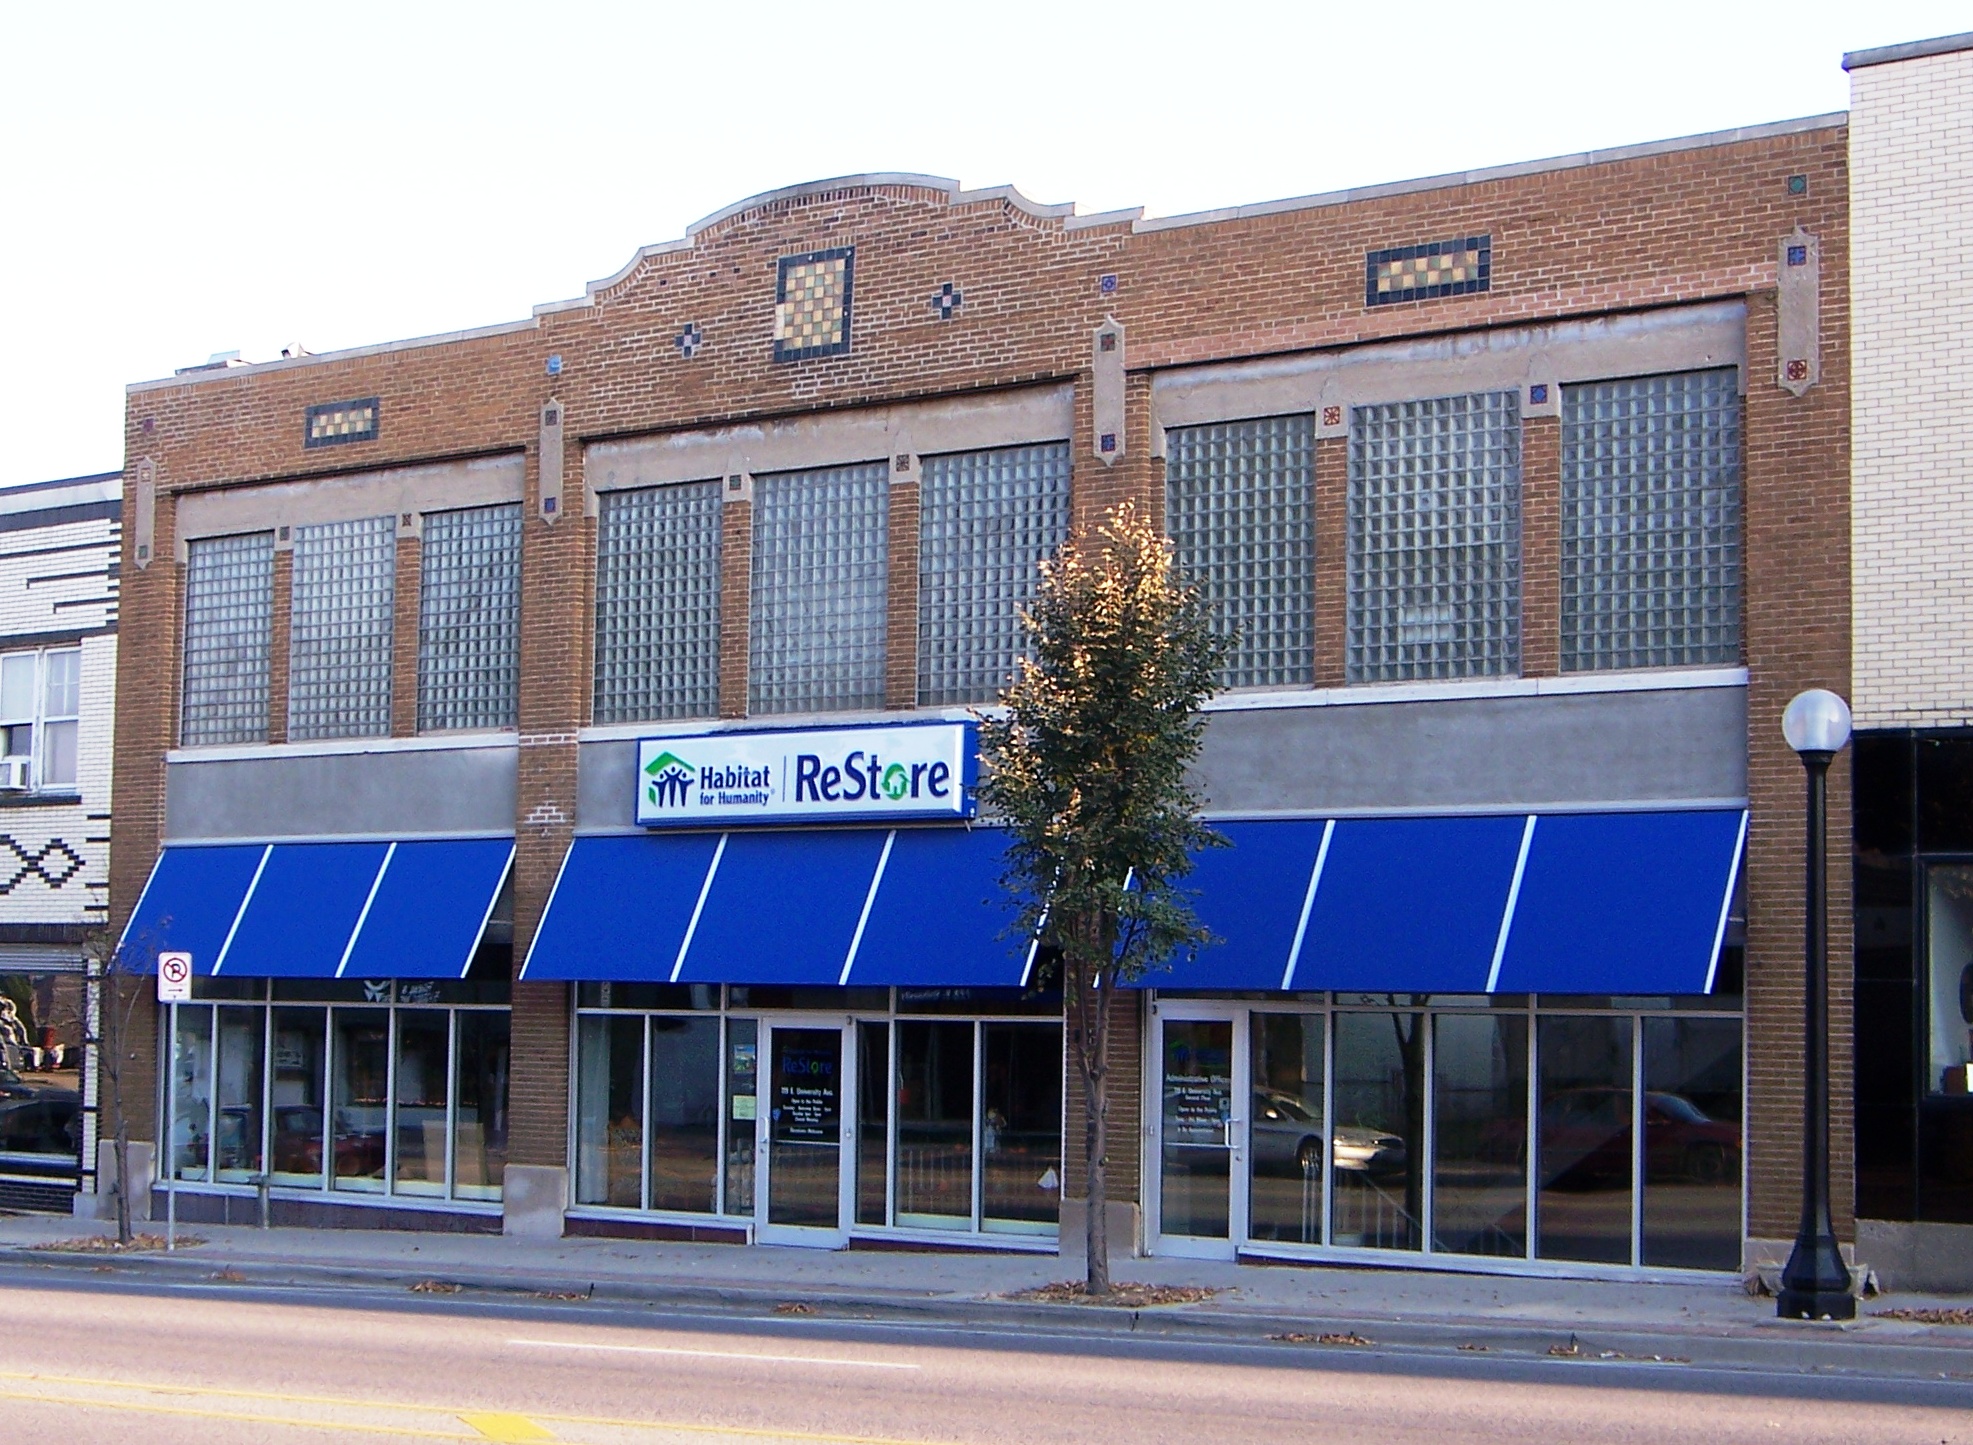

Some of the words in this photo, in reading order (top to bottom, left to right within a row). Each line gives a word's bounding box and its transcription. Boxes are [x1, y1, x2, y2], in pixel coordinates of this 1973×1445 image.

[700, 765, 770, 789] Habitat
[796, 751, 949, 802] ReStore
[700, 792, 715, 806] for
[718, 789, 770, 807] Humanity
